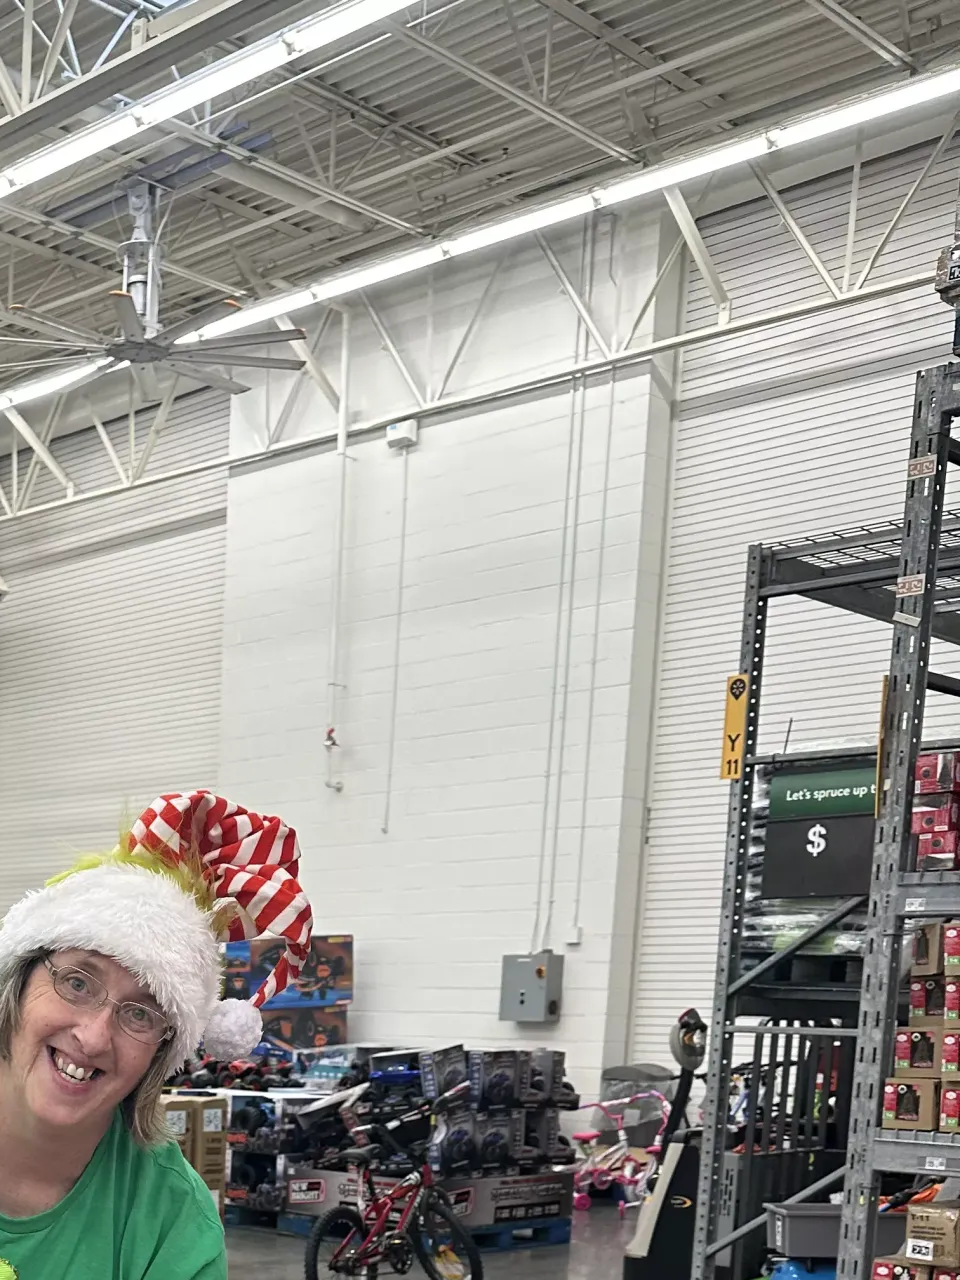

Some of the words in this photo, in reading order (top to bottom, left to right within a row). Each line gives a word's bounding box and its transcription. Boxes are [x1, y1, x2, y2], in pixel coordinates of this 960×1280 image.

[727, 733, 742, 752] Y
[726, 759, 739, 776] 11
[786, 788, 811, 802] Let's
[813, 786, 850, 802] spruce
[853, 786, 869, 800] up
